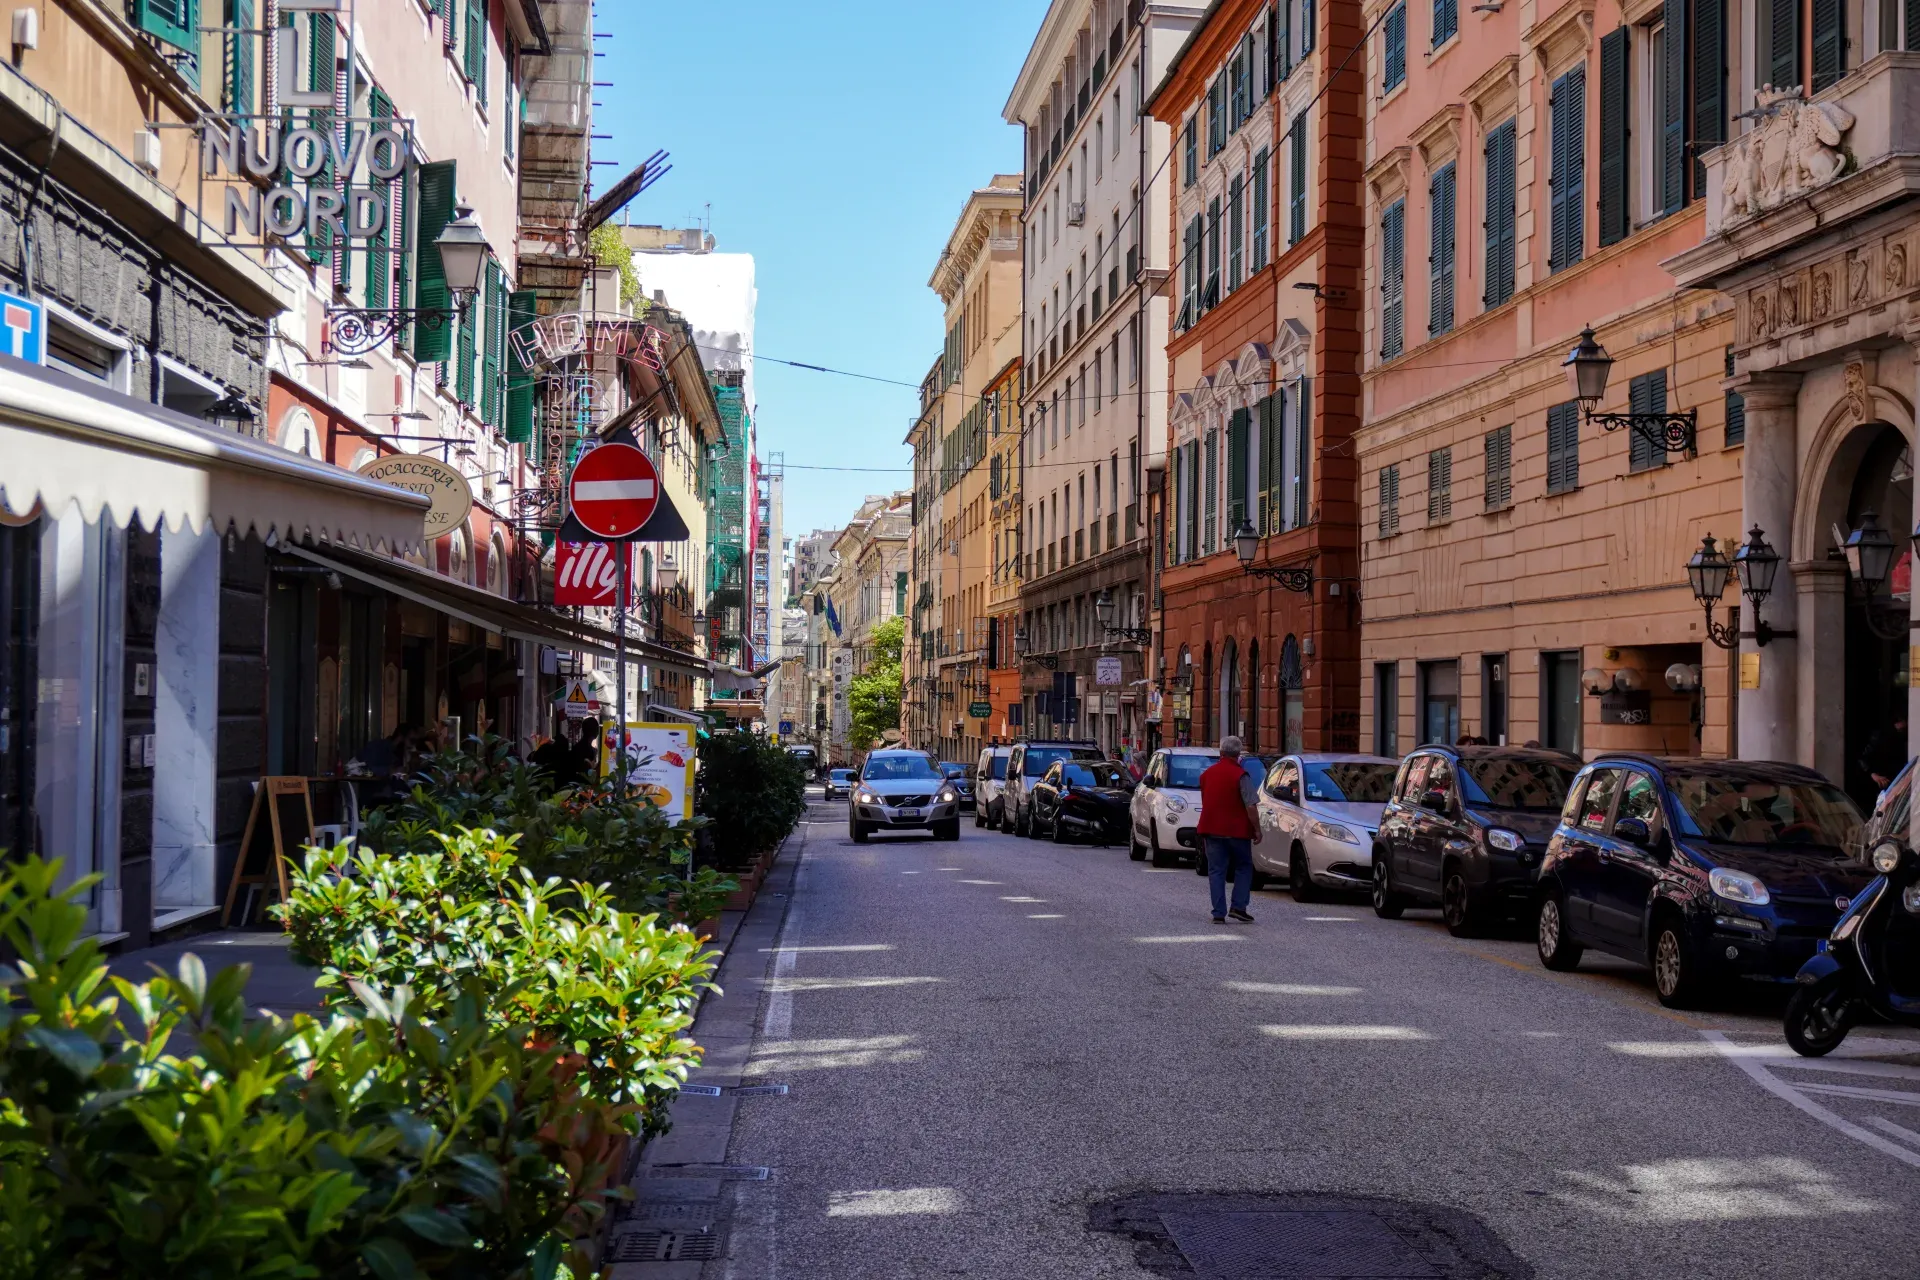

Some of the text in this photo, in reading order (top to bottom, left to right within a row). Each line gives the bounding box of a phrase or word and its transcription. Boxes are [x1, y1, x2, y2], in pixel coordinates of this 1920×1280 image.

[205, 125, 408, 180] NUOVO
[224, 186, 385, 238] NORD
[511, 313, 672, 371] HOME
[549, 377, 563, 518] RISTORANTE
[559, 541, 628, 600] illy
[711, 617, 721, 661] HOTE
